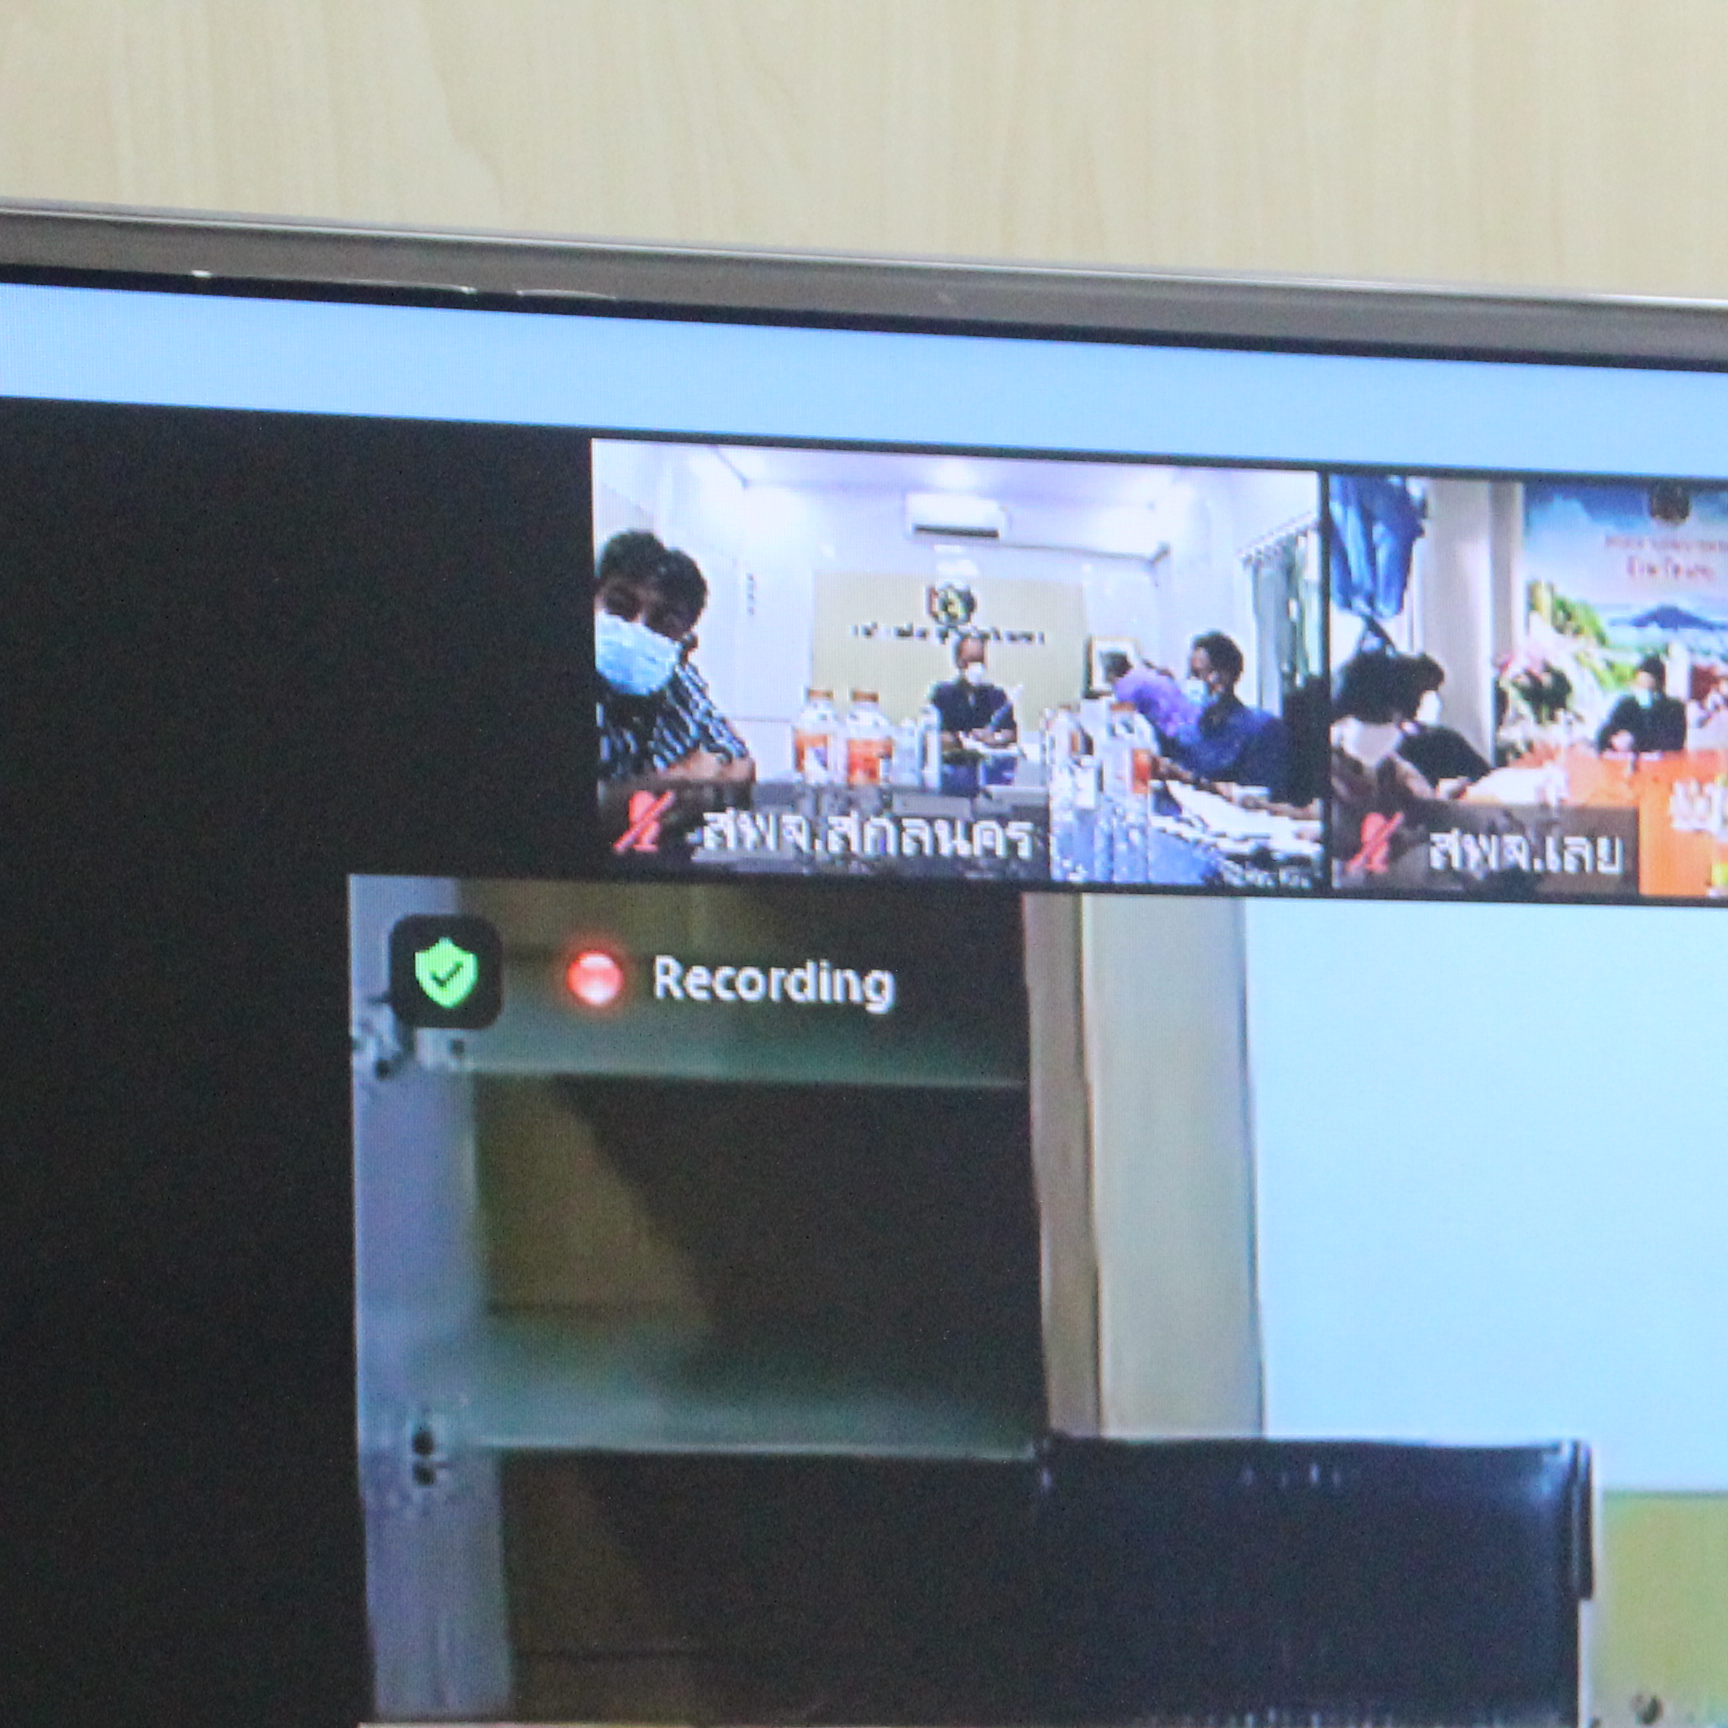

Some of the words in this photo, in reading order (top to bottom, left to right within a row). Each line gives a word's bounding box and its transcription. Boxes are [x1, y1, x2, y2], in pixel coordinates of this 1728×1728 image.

[702, 806, 1035, 860] สพจ.สกลนคร
[652, 953, 898, 1014] Recording
